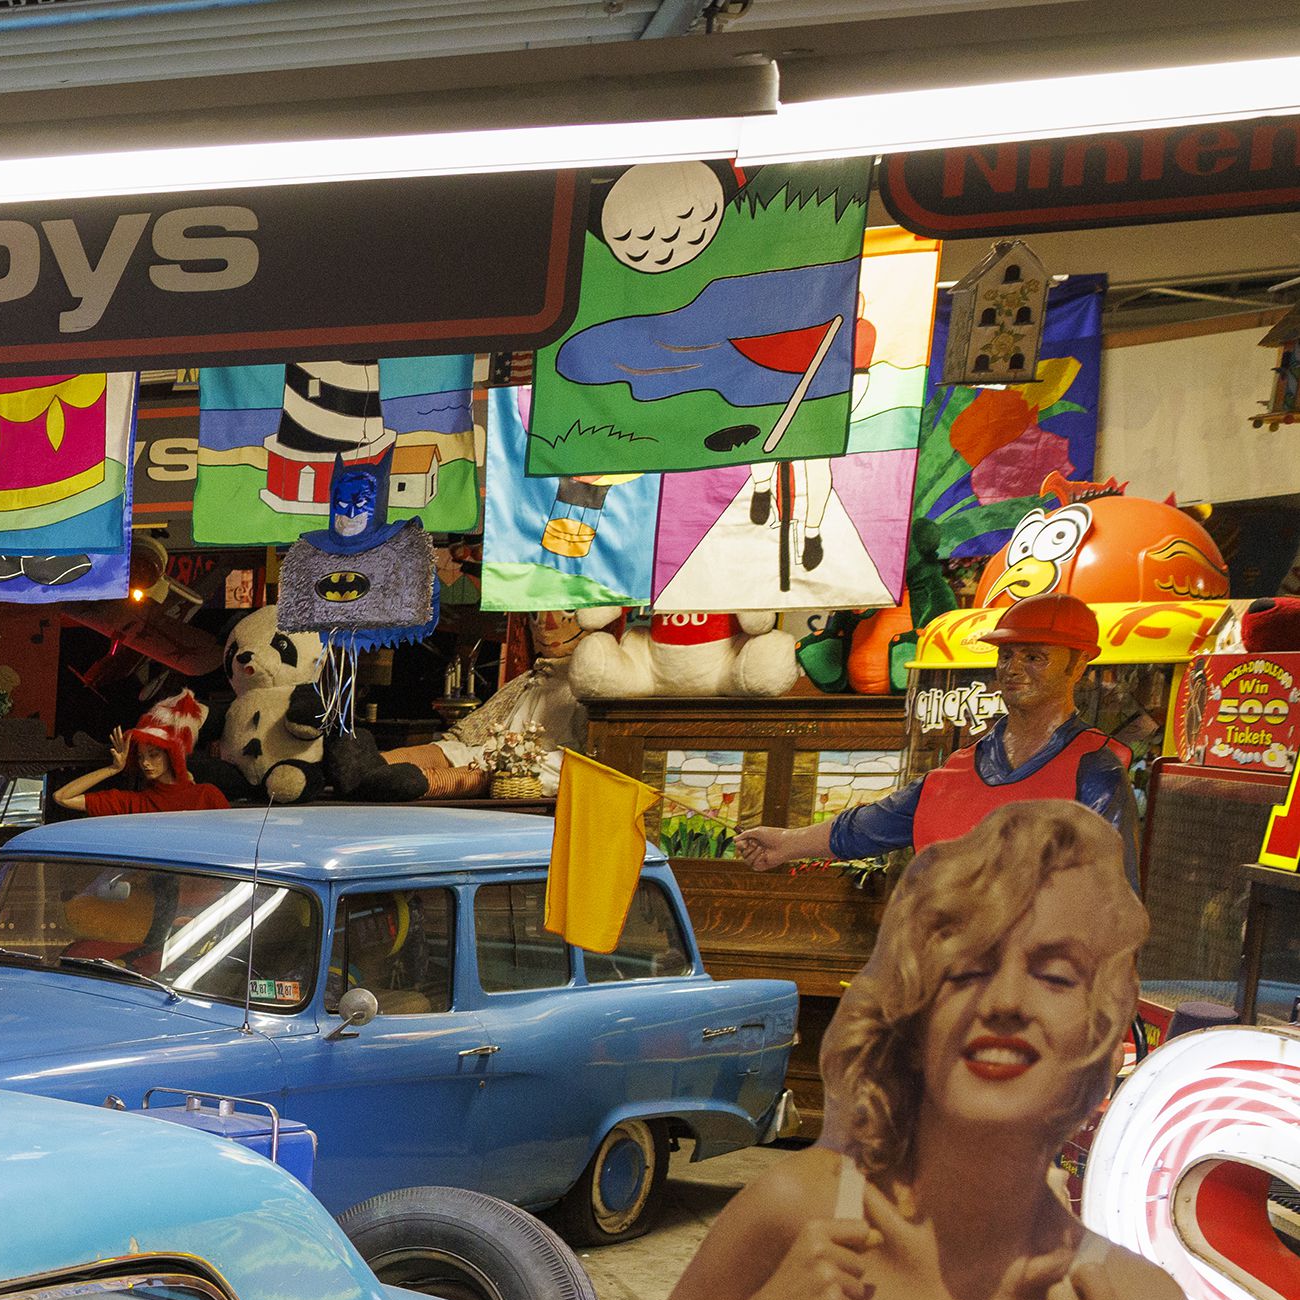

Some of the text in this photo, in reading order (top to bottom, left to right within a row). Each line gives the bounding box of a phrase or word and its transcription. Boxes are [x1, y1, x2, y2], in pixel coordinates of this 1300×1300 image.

[1238, 678, 1269, 694] Win
[1216, 698, 1289, 725] 500
[1225, 725, 1273, 746] Tickets
